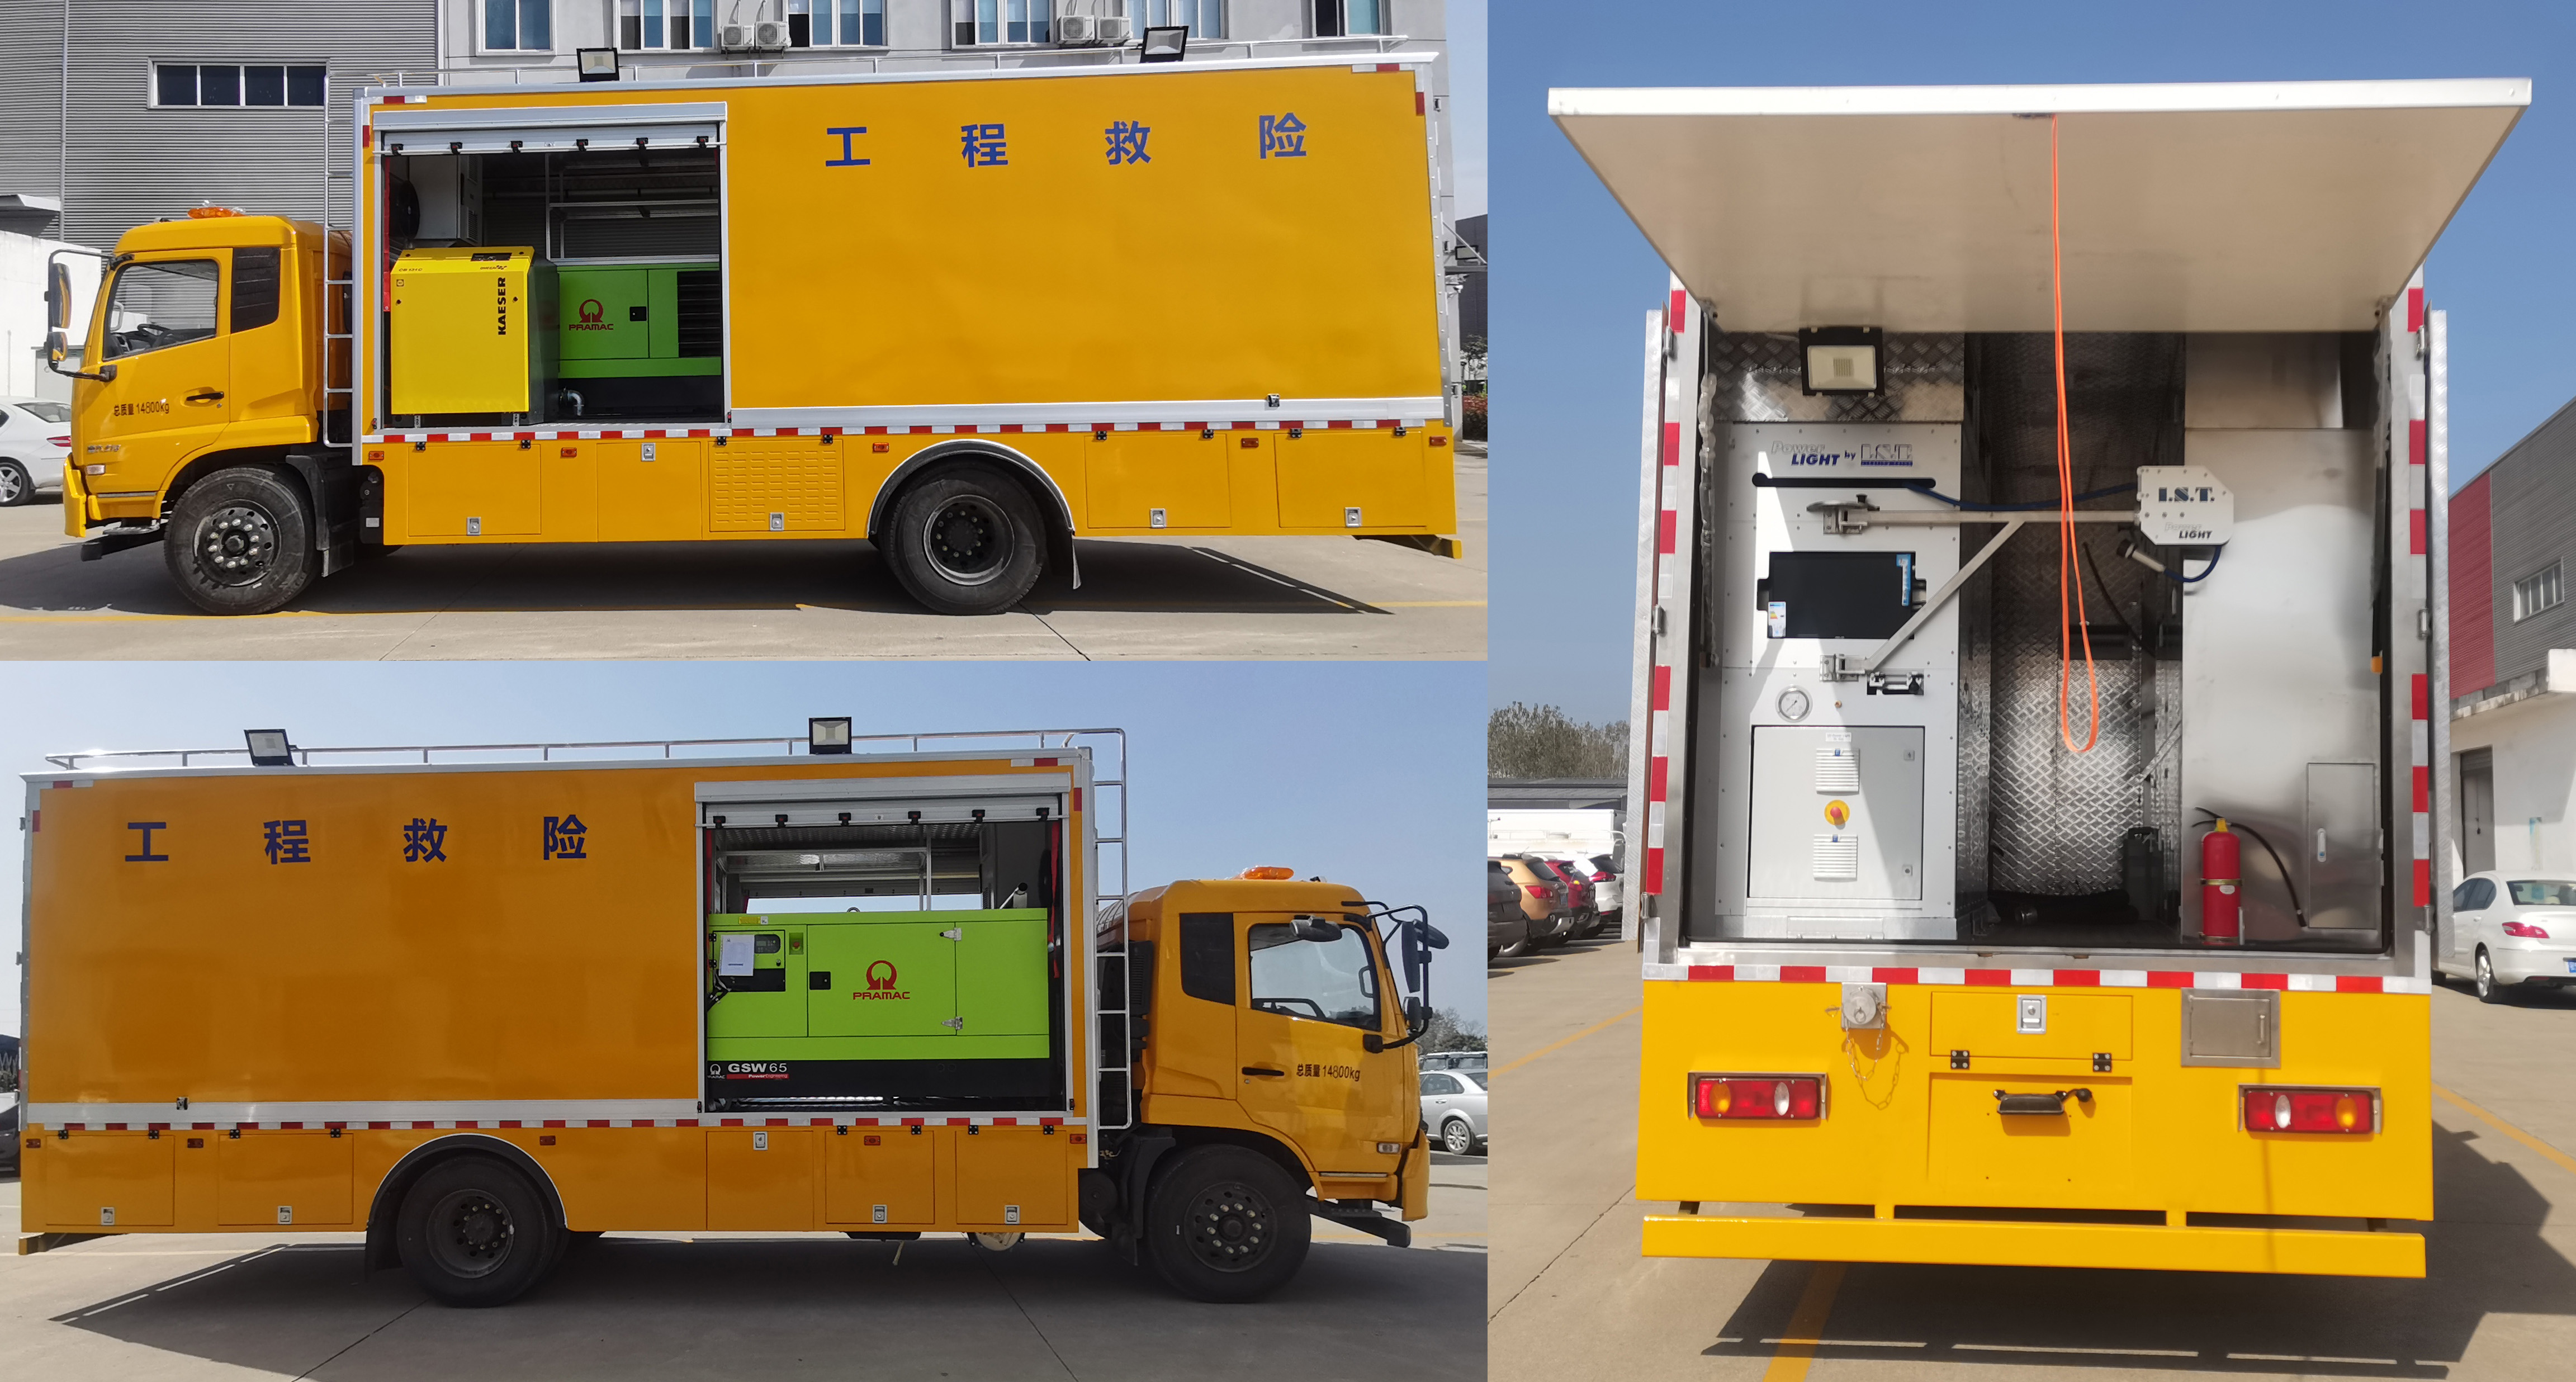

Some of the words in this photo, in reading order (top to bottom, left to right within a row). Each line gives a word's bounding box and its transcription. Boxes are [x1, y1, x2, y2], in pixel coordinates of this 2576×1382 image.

[825, 112, 1308, 168] 工程救险
[498, 277, 506, 335] KAESER
[113, 403, 134, 417] 总质量
[1771, 440, 1825, 454] Power
[1791, 453, 1840, 466] LIGHT
[1845, 450, 1856, 461] by
[2158, 486, 2215, 502] I.S.T.
[2164, 522, 2202, 532] Power
[2179, 530, 2213, 539] LIGHT
[125, 814, 588, 865] 工程救险
[853, 991, 911, 1000] PRAMAC
[728, 1063, 767, 1073] GSW
[769, 1063, 787, 1073] 65
[1296, 1063, 1320, 1077] 总质量
[1323, 1065, 1361, 1082] 14800kg
